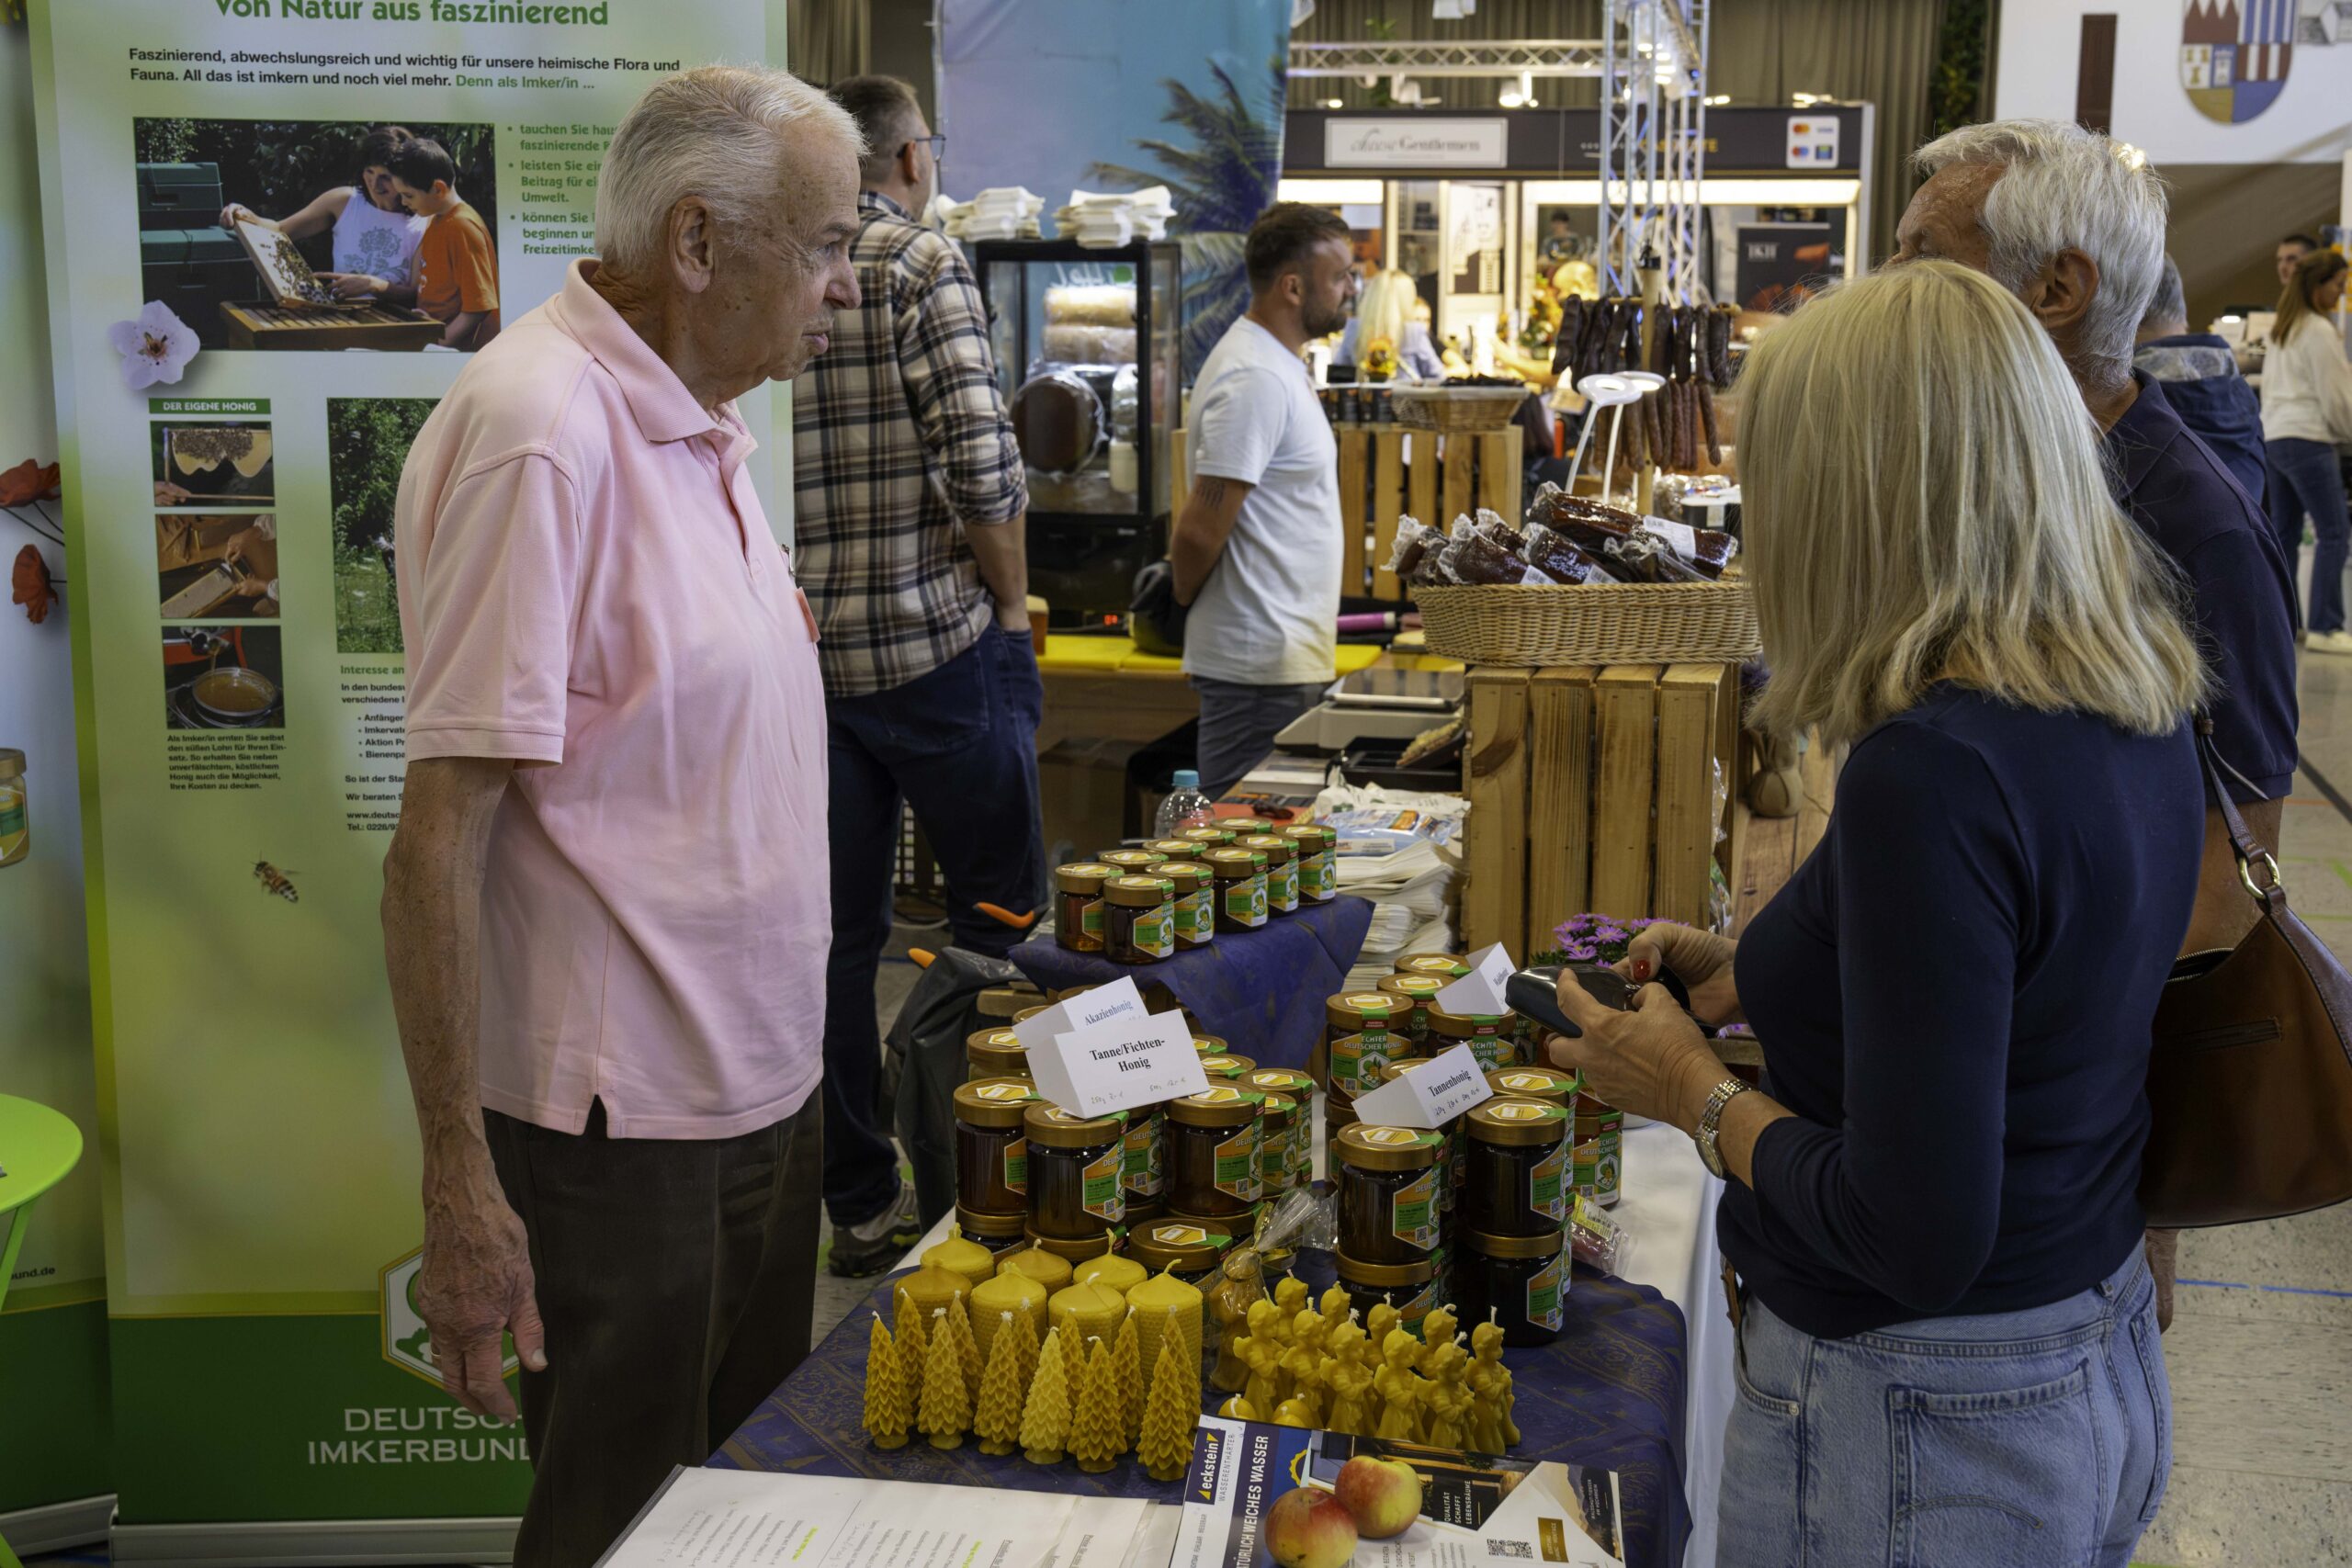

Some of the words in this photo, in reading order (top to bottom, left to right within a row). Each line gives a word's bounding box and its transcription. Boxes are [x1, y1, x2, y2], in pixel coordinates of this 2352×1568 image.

[282, 0, 363, 19] Natur
[372, 2, 420, 21] aus
[430, 0, 608, 25] faszinierend
[130, 48, 226, 63] Faszinierend,
[231, 51, 369, 66] abwechslungsreich
[375, 53, 401, 66] und
[406, 55, 457, 69] wichtig
[462, 55, 481, 68] für
[486, 59, 534, 69] unsere
[538, 57, 609, 70] heimische
[614, 58, 650, 71] Flora
[653, 60, 680, 71] und
[130, 68, 178, 81] Fauna.
[183, 69, 201, 81] All
[206, 70, 232, 82] das
[237, 71, 254, 83] ist
[259, 71, 308, 84] imkern
[313, 73, 339, 85] und
[344, 73, 379, 85] noch
[383, 73, 407, 85] viel
[412, 74, 451, 86] mehr.
[456, 75, 493, 87] Denn
[497, 75, 517, 88] als
[522, 76, 579, 89] Imker/in
[520, 124, 567, 134] tauchen
[571, 124, 589, 135] Sie
[520, 140, 600, 151] faszinierende
[521, 160, 561, 171] leisten
[565, 161, 582, 171] Sie
[521, 176, 562, 188] Beitrag
[567, 177, 582, 187] für
[522, 192, 570, 203] Umwelt.
[522, 212, 567, 223] können
[571, 213, 588, 223] Sie
[523, 228, 578, 240] beginnen
[524, 244, 594, 254] Freizeitimke
[163, 401, 182, 411] DER
[185, 402, 220, 411] EIGENE
[222, 402, 256, 411] HONIG
[340, 665, 389, 674] Interesse
[345, 774, 356, 783] So
[358, 774, 369, 783] ist
[371, 774, 386, 783] der
[345, 793, 360, 801] Wir
[363, 793, 396, 801] beraten
[1084, 999, 1134, 1026] Akazienhonig
[1089, 1038, 1165, 1061] Tanne/Fichten-
[1118, 1058, 1151, 1072] Honig
[1428, 1069, 1472, 1098] Tannenhonig
[1250, 1436, 1269, 1483] WASSER
[1201, 1443, 1219, 1490] eckstein
[1442, 1492, 1452, 1522] QUALITÄT
[1464, 1480, 1472, 1525] LEBENSRÄUME
[1242, 1485, 1262, 1536] WEICHES
